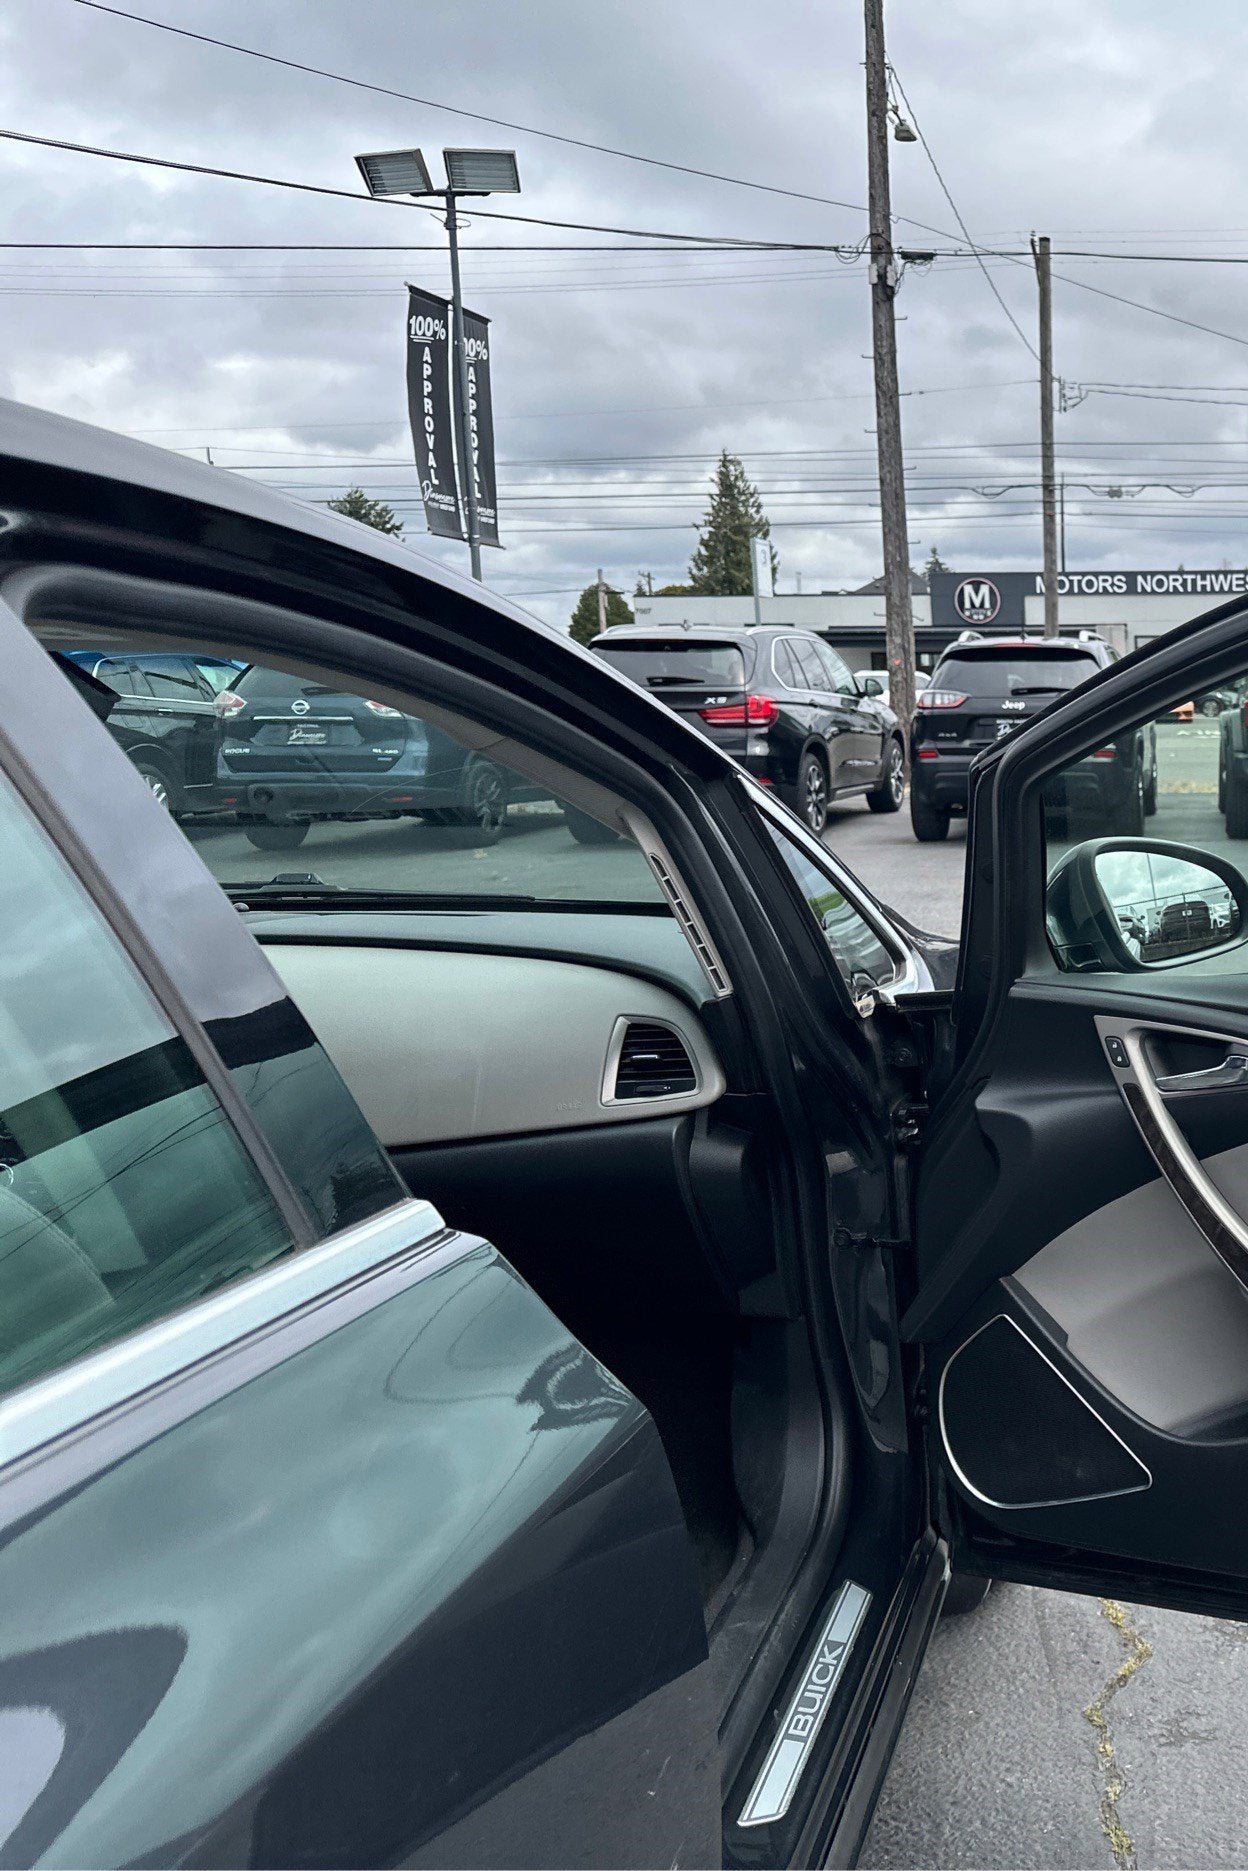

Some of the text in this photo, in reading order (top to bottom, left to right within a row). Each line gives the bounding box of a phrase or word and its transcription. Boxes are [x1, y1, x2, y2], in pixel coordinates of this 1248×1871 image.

[409, 315, 446, 341] 100%
[422, 346, 439, 485] APPROVAL
[467, 366, 482, 499] APPROVAL
[1002, 700, 1026, 711] Jeep
[787, 1644, 844, 1737] BUICK
